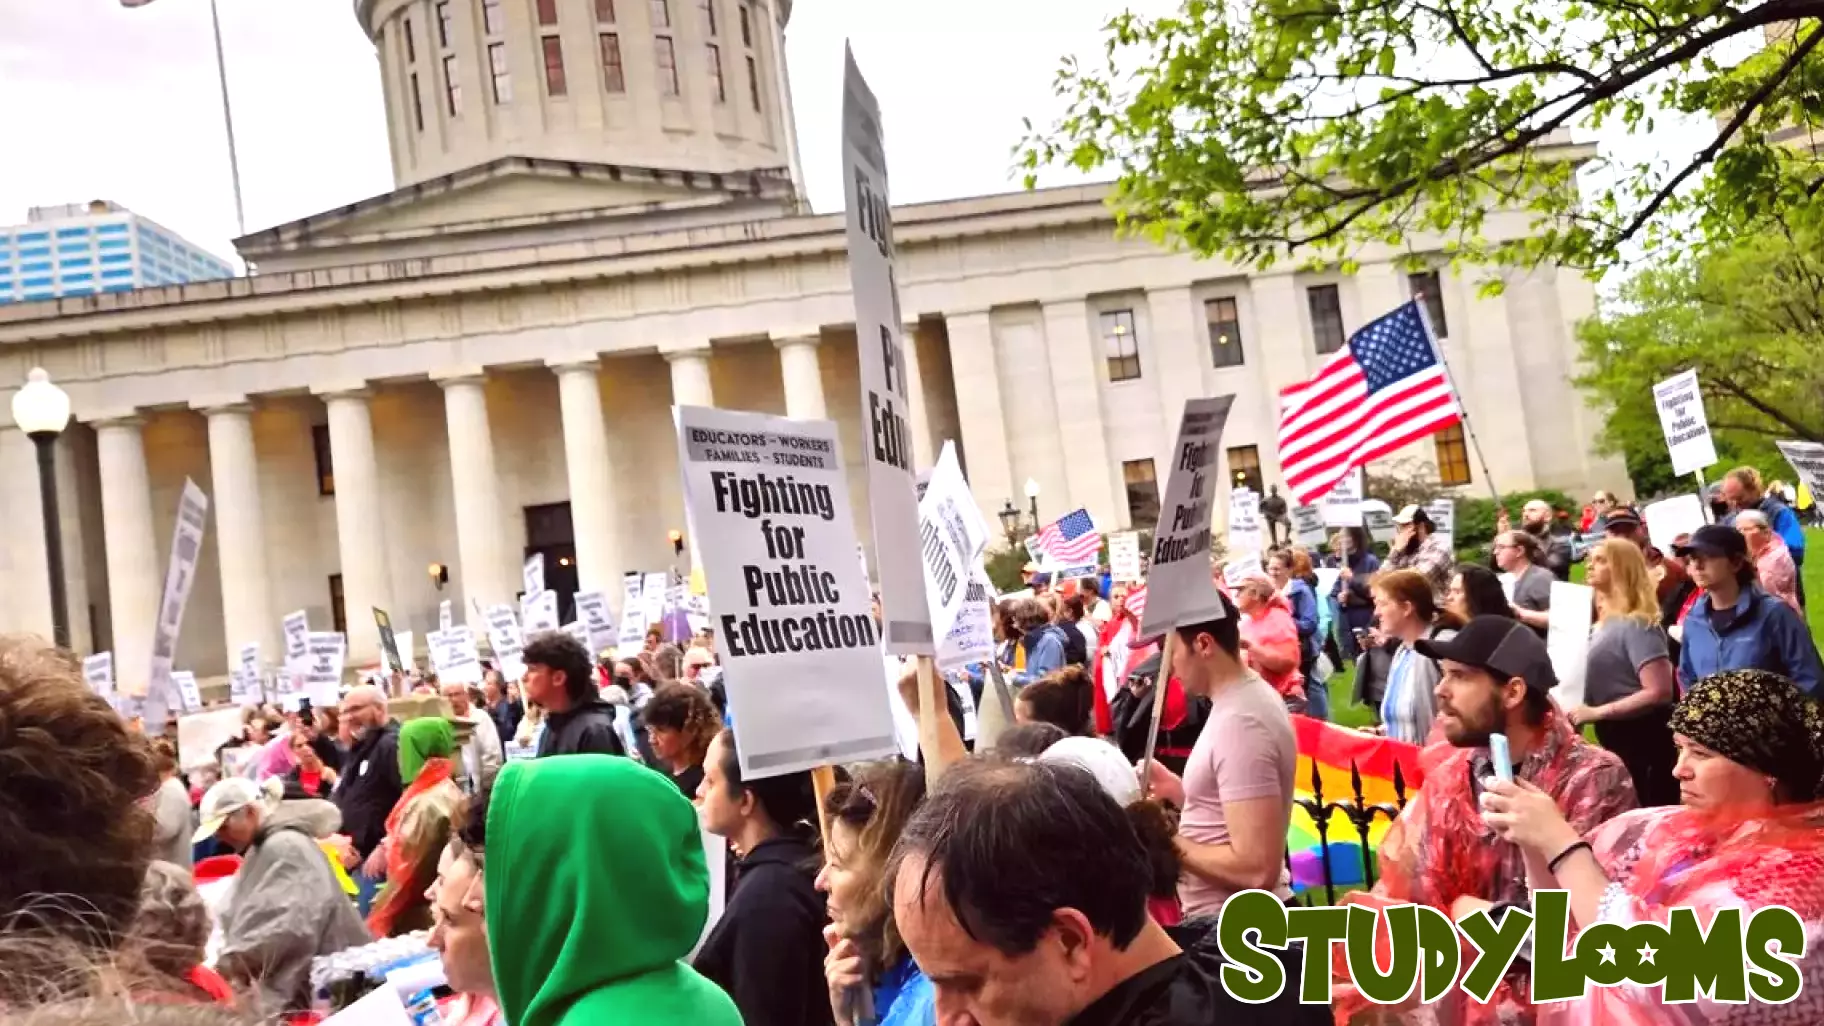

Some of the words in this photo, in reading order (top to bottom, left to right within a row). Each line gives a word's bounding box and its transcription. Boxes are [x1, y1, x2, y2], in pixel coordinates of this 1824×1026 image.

[692, 430, 766, 445] EDUCATORS
[778, 437, 830, 452] WORKERS
[705, 449, 760, 463] FAMILIES
[773, 452, 824, 468] STUDENTS
[711, 471, 835, 521] Fighting
[761, 519, 804, 559] for
[743, 564, 840, 607] Public
[720, 609, 875, 657] Education
